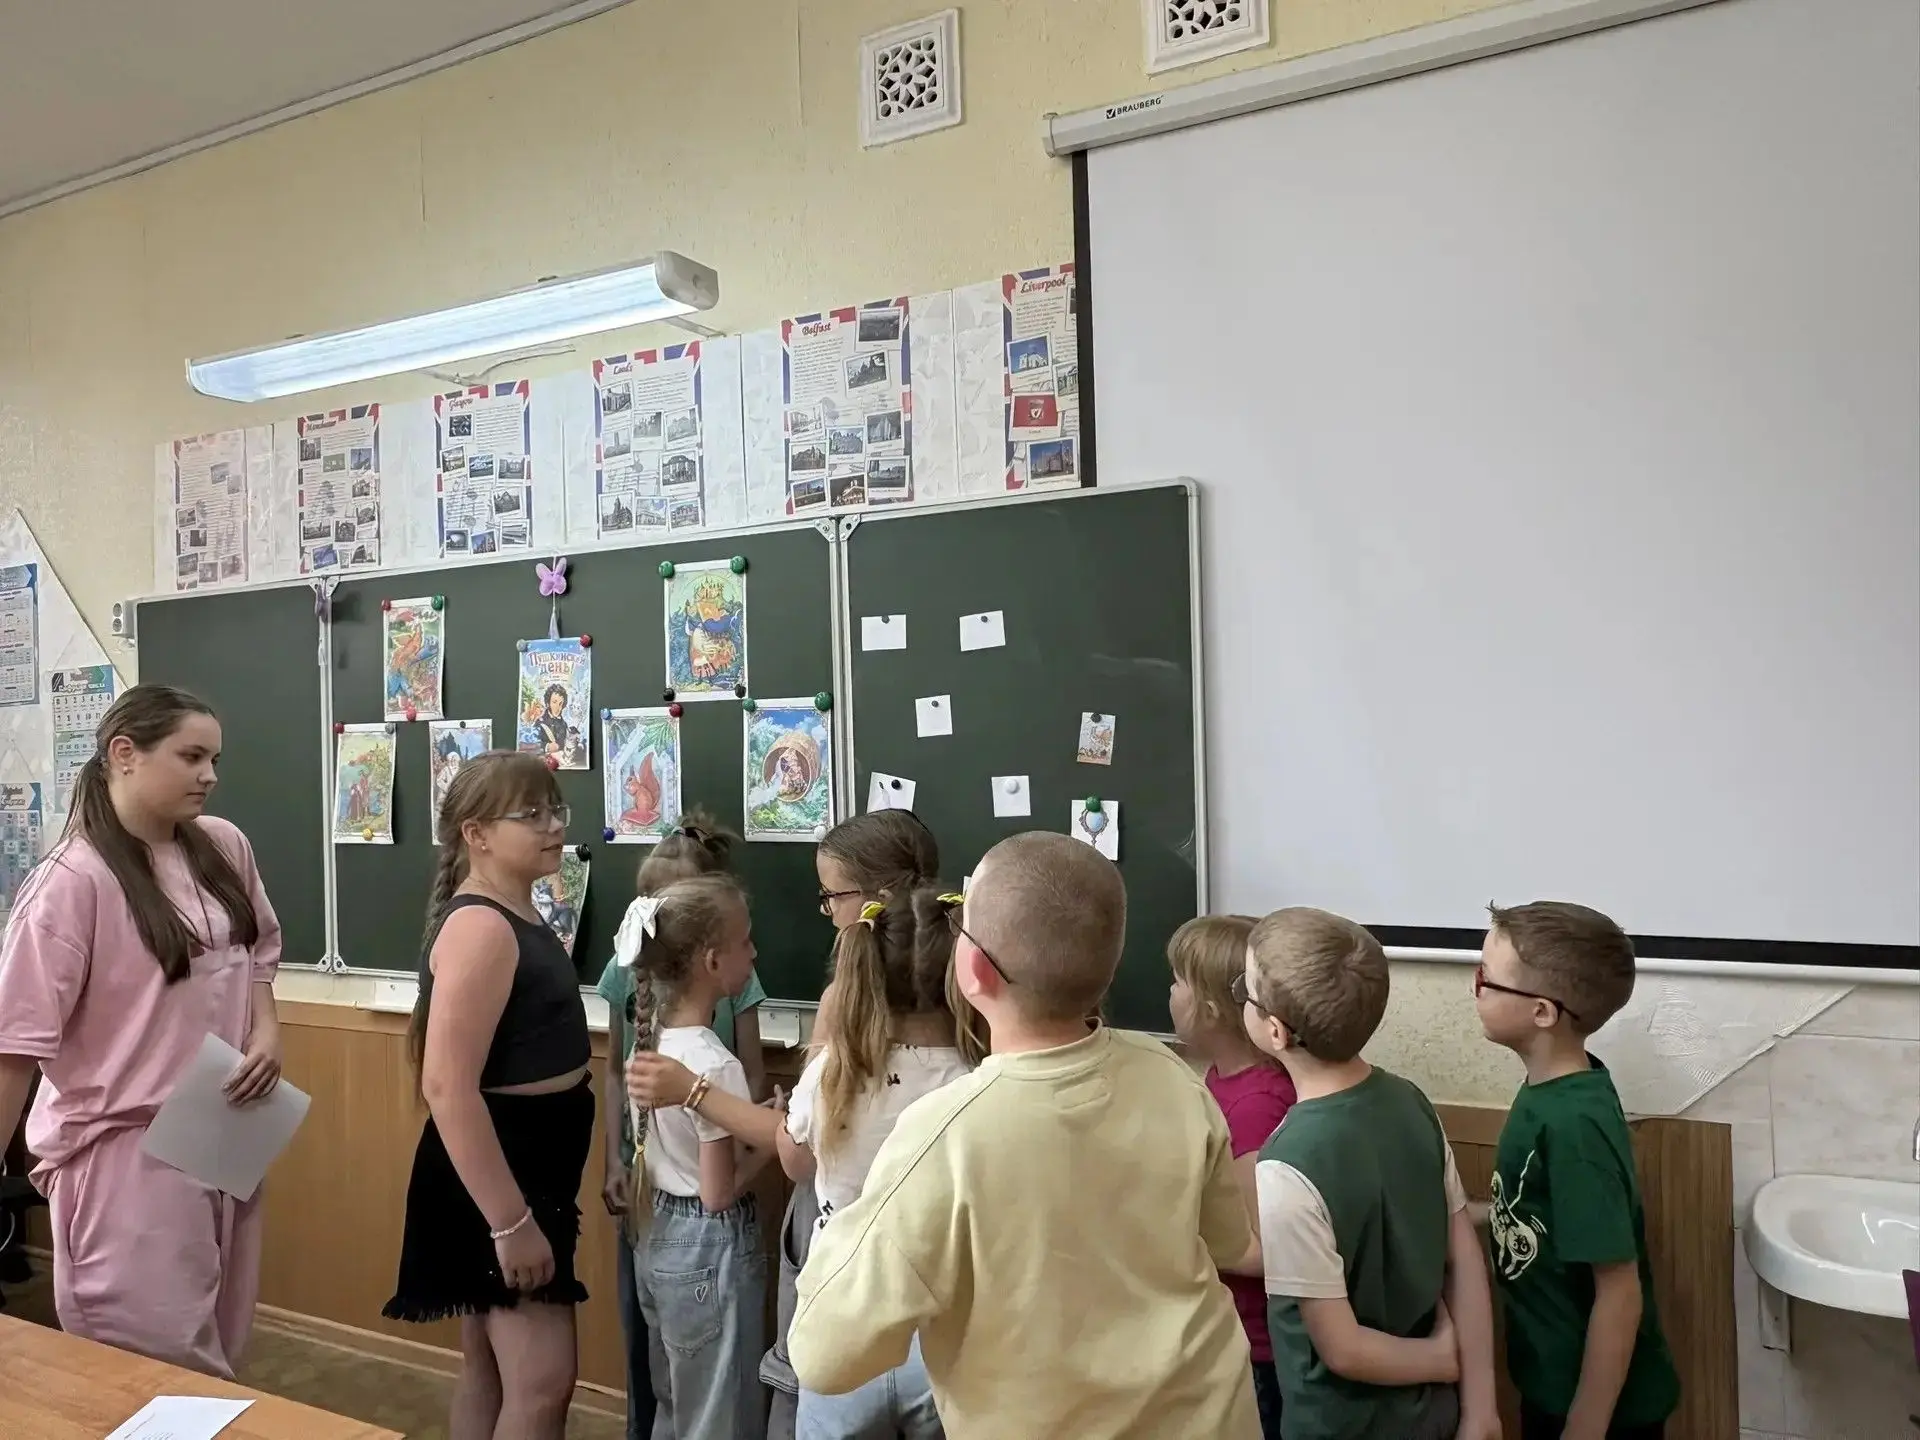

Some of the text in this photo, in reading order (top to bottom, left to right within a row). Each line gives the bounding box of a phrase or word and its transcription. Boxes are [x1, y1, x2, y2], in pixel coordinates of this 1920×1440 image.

[1117, 97, 1161, 115] BRAUBERG
[1020, 273, 1068, 293] Liverpool
[801, 321, 832, 338] Belfast
